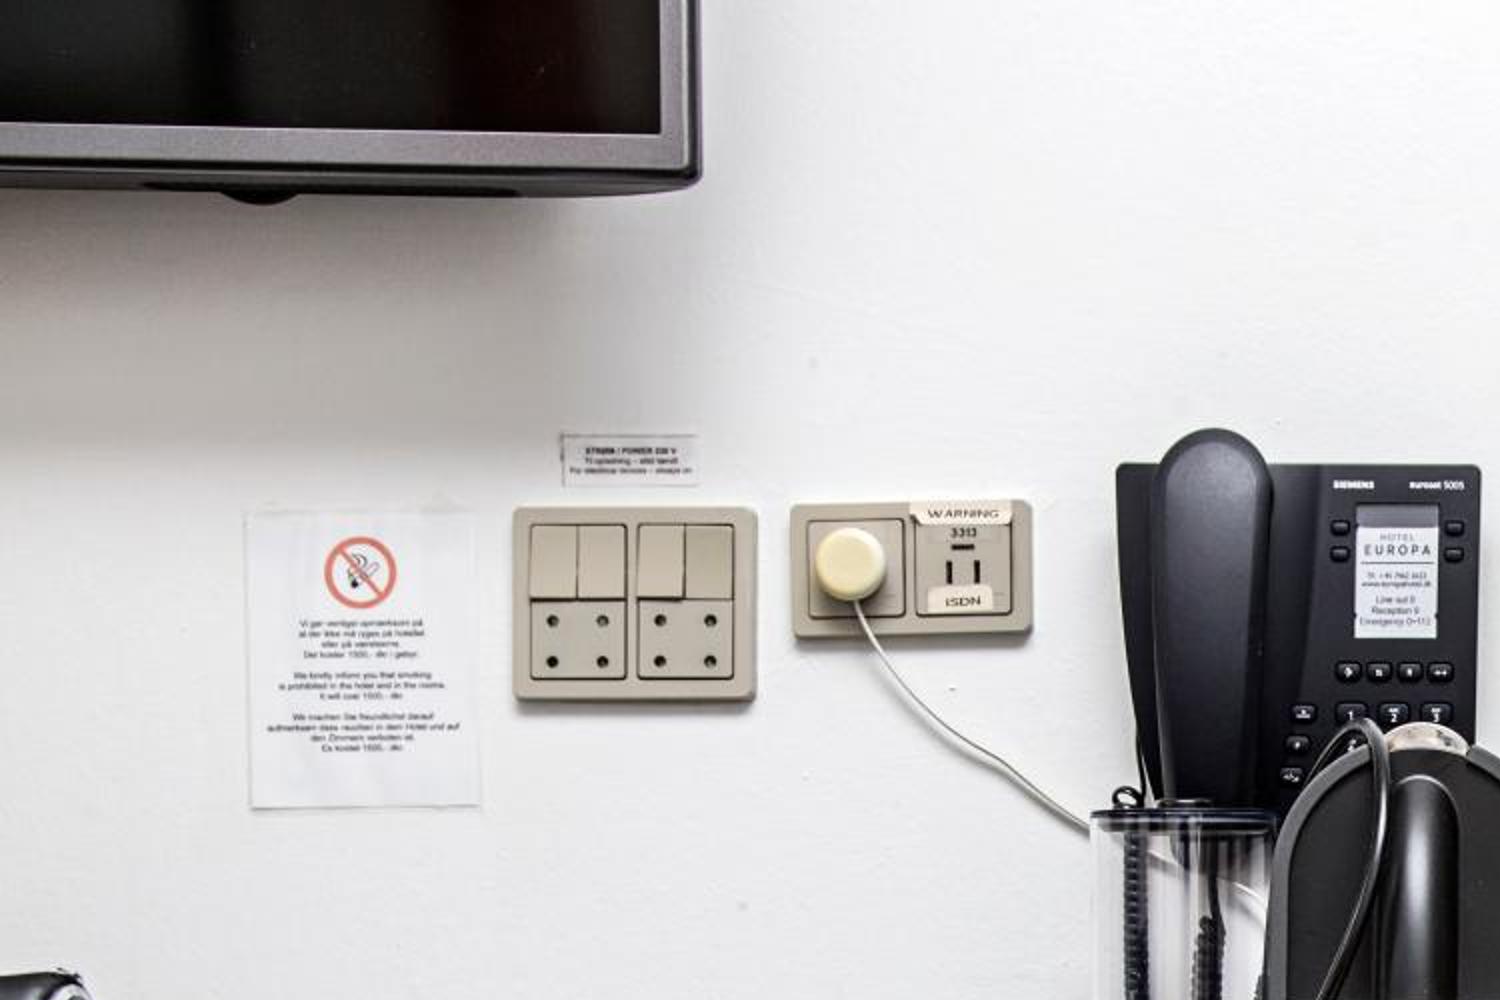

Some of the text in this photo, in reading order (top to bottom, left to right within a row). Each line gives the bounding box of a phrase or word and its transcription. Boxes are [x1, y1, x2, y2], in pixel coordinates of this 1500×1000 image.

[1333, 480, 1375, 489] SIEMENS
[928, 509, 1000, 519] WARNING
[1380, 533, 1413, 541] HOTEL
[1364, 544, 1430, 556] EUROPA
[946, 596, 981, 607] ISDN
